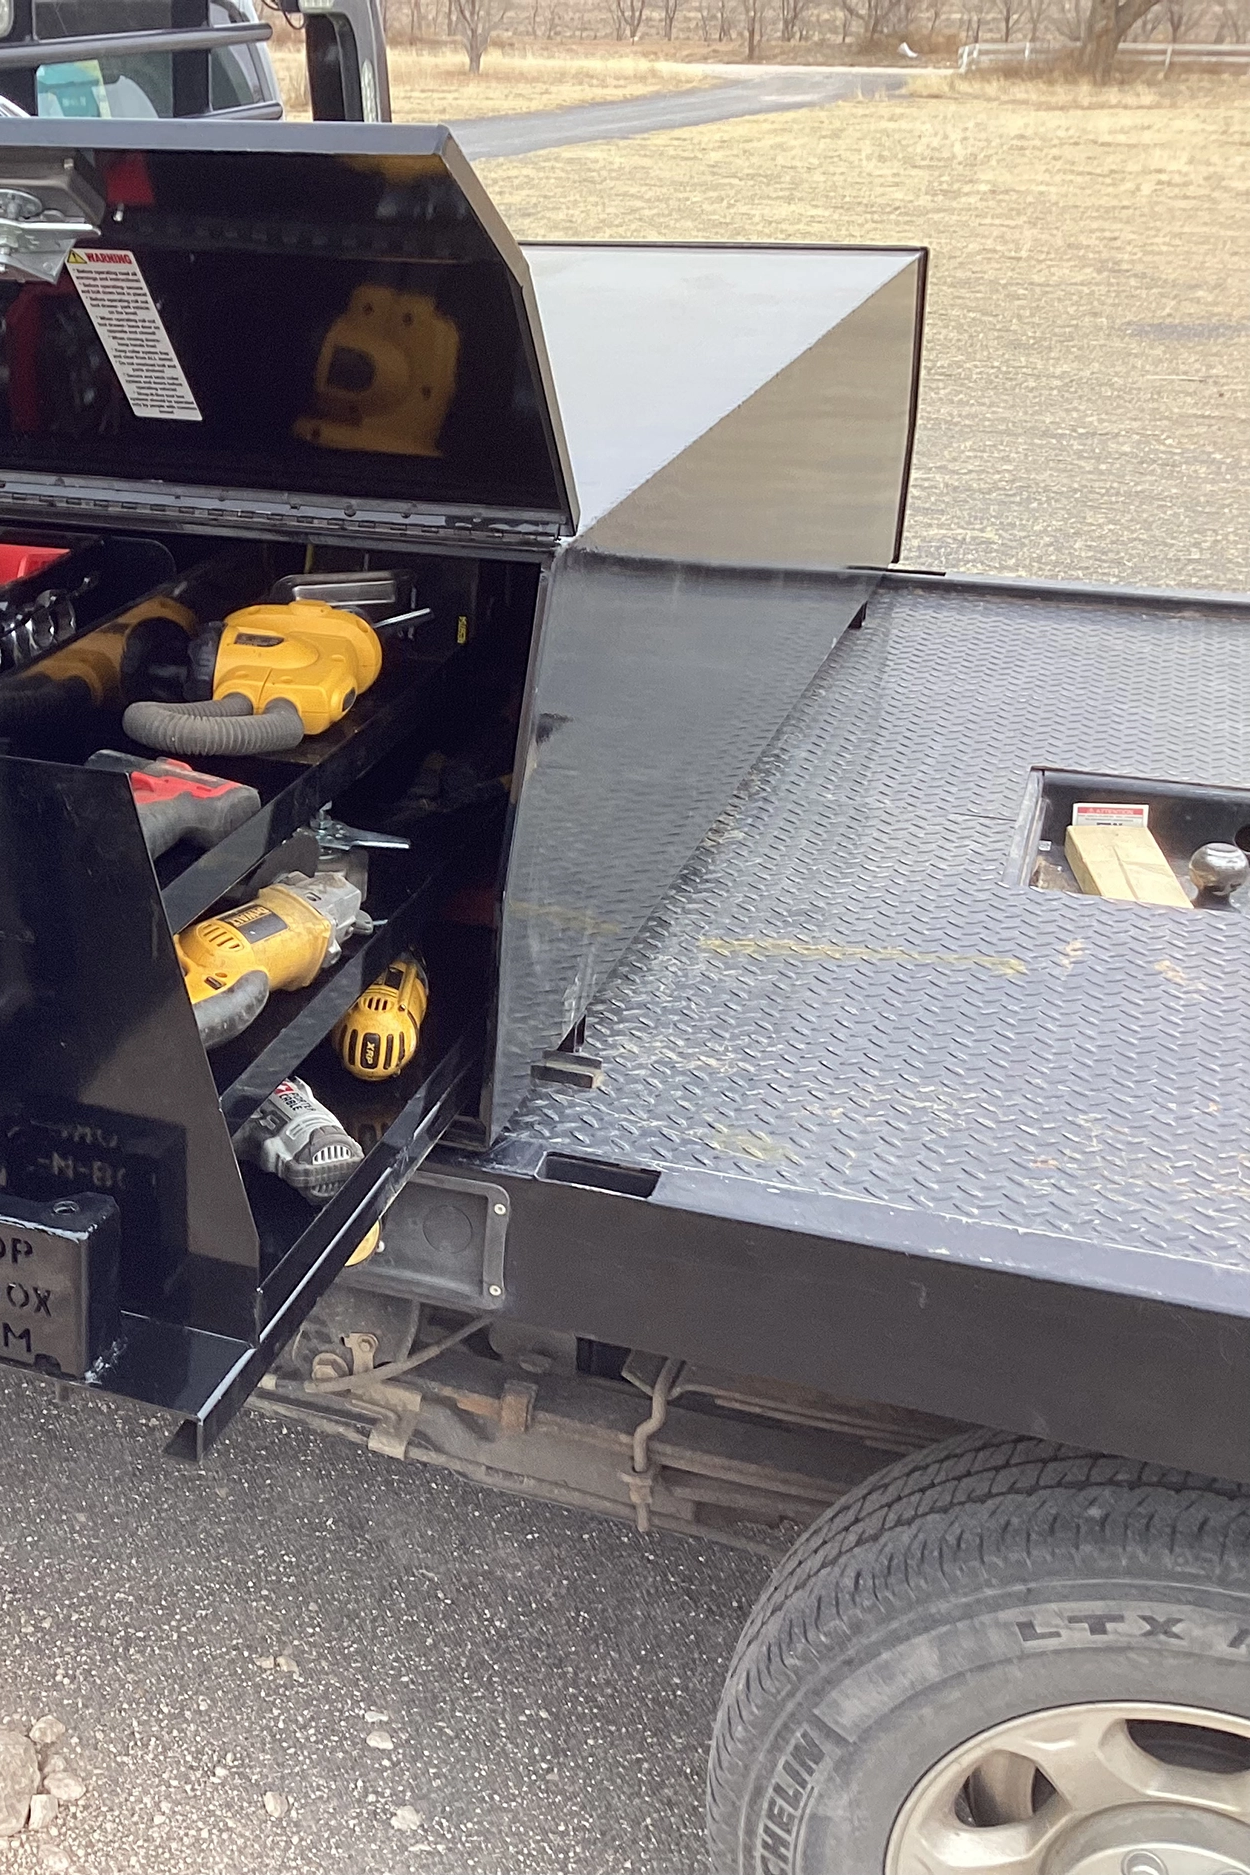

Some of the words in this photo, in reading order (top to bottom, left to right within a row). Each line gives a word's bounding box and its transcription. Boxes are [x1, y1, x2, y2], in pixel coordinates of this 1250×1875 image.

[85, 253, 132, 264] WARNING
[365, 1041, 375, 1065] XRP
[1015, 1613, 1186, 1643] LTX
